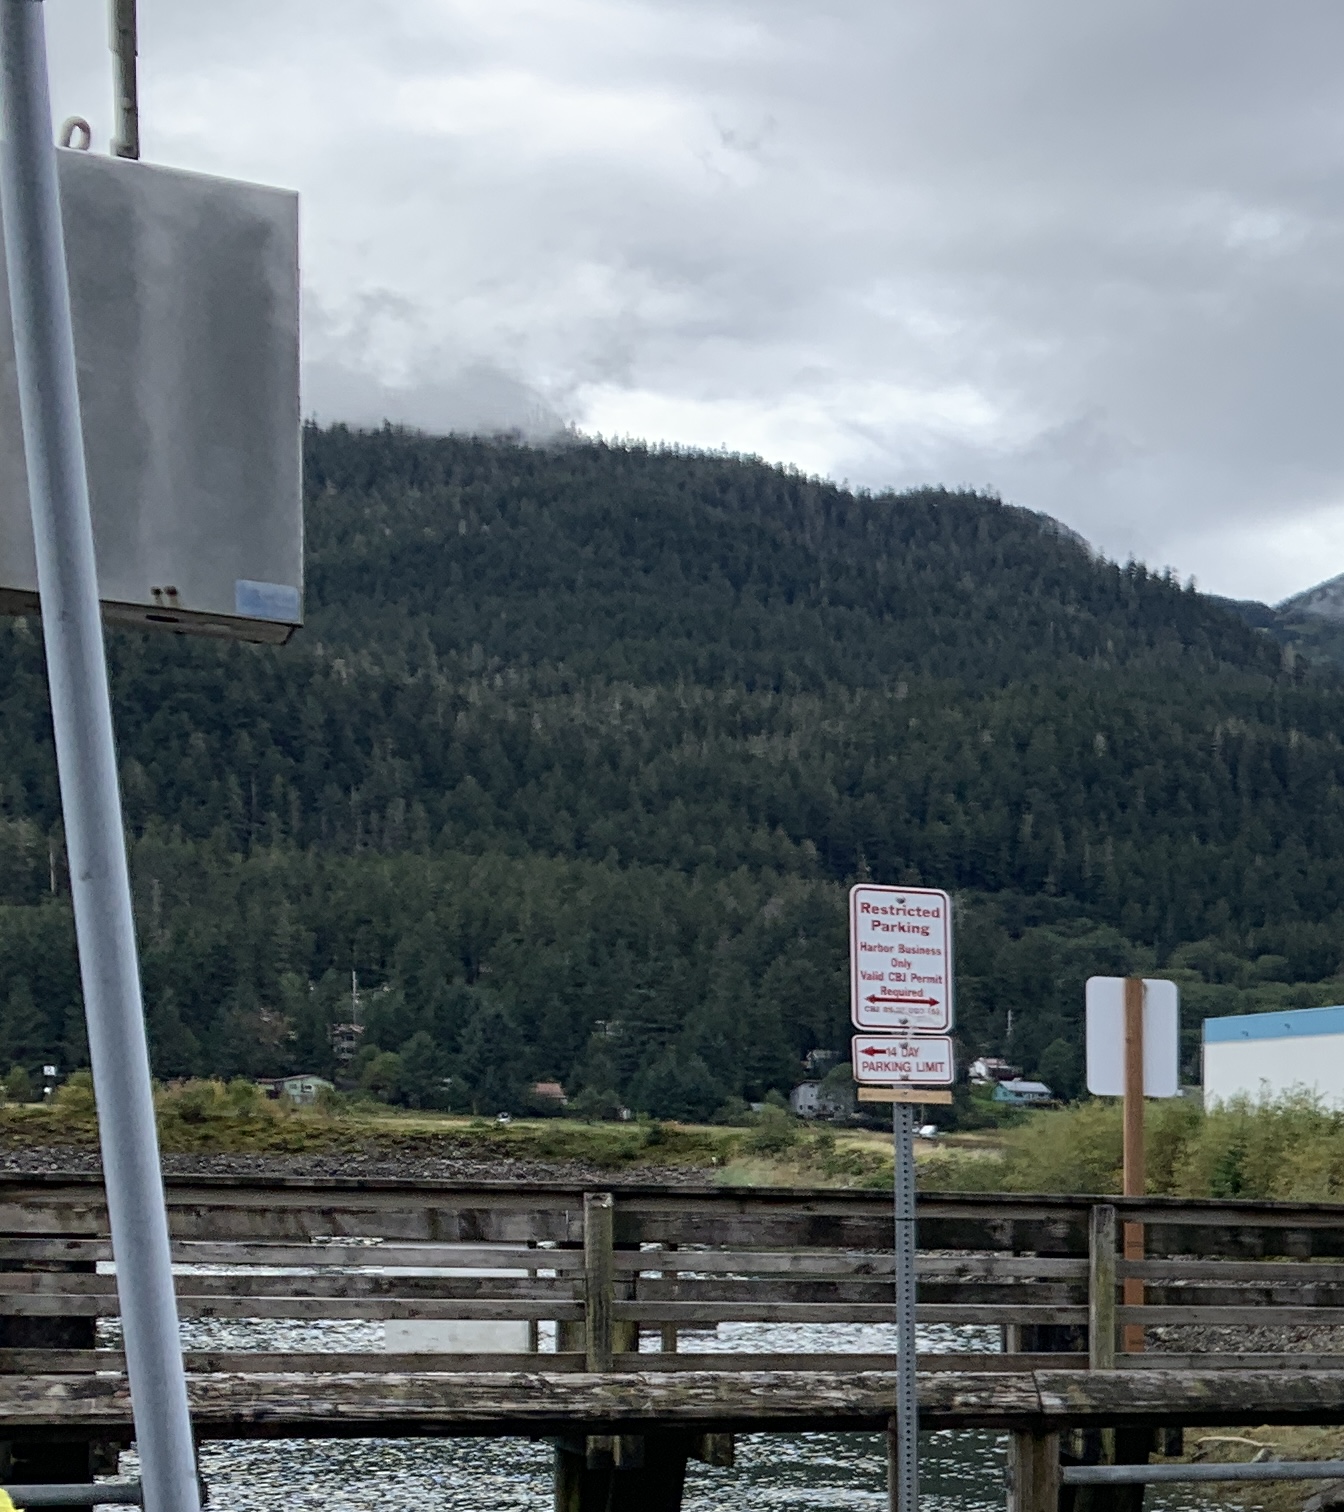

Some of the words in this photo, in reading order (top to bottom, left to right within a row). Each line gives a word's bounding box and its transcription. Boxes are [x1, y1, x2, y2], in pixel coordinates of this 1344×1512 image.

[860, 902, 940, 918] Restricted
[871, 920, 930, 936] Parking
[859, 942, 894, 953] Harbor
[898, 944, 941, 955] Business
[891, 958, 912, 970] Only
[860, 971, 884, 982] Valid
[888, 972, 906, 982] CBJ
[911, 973, 943, 984] Permit
[880, 986, 924, 998] Required
[901, 1047, 920, 1057] DAY
[862, 1061, 912, 1073] PARKING
[916, 1062, 945, 1073] LIMIT
